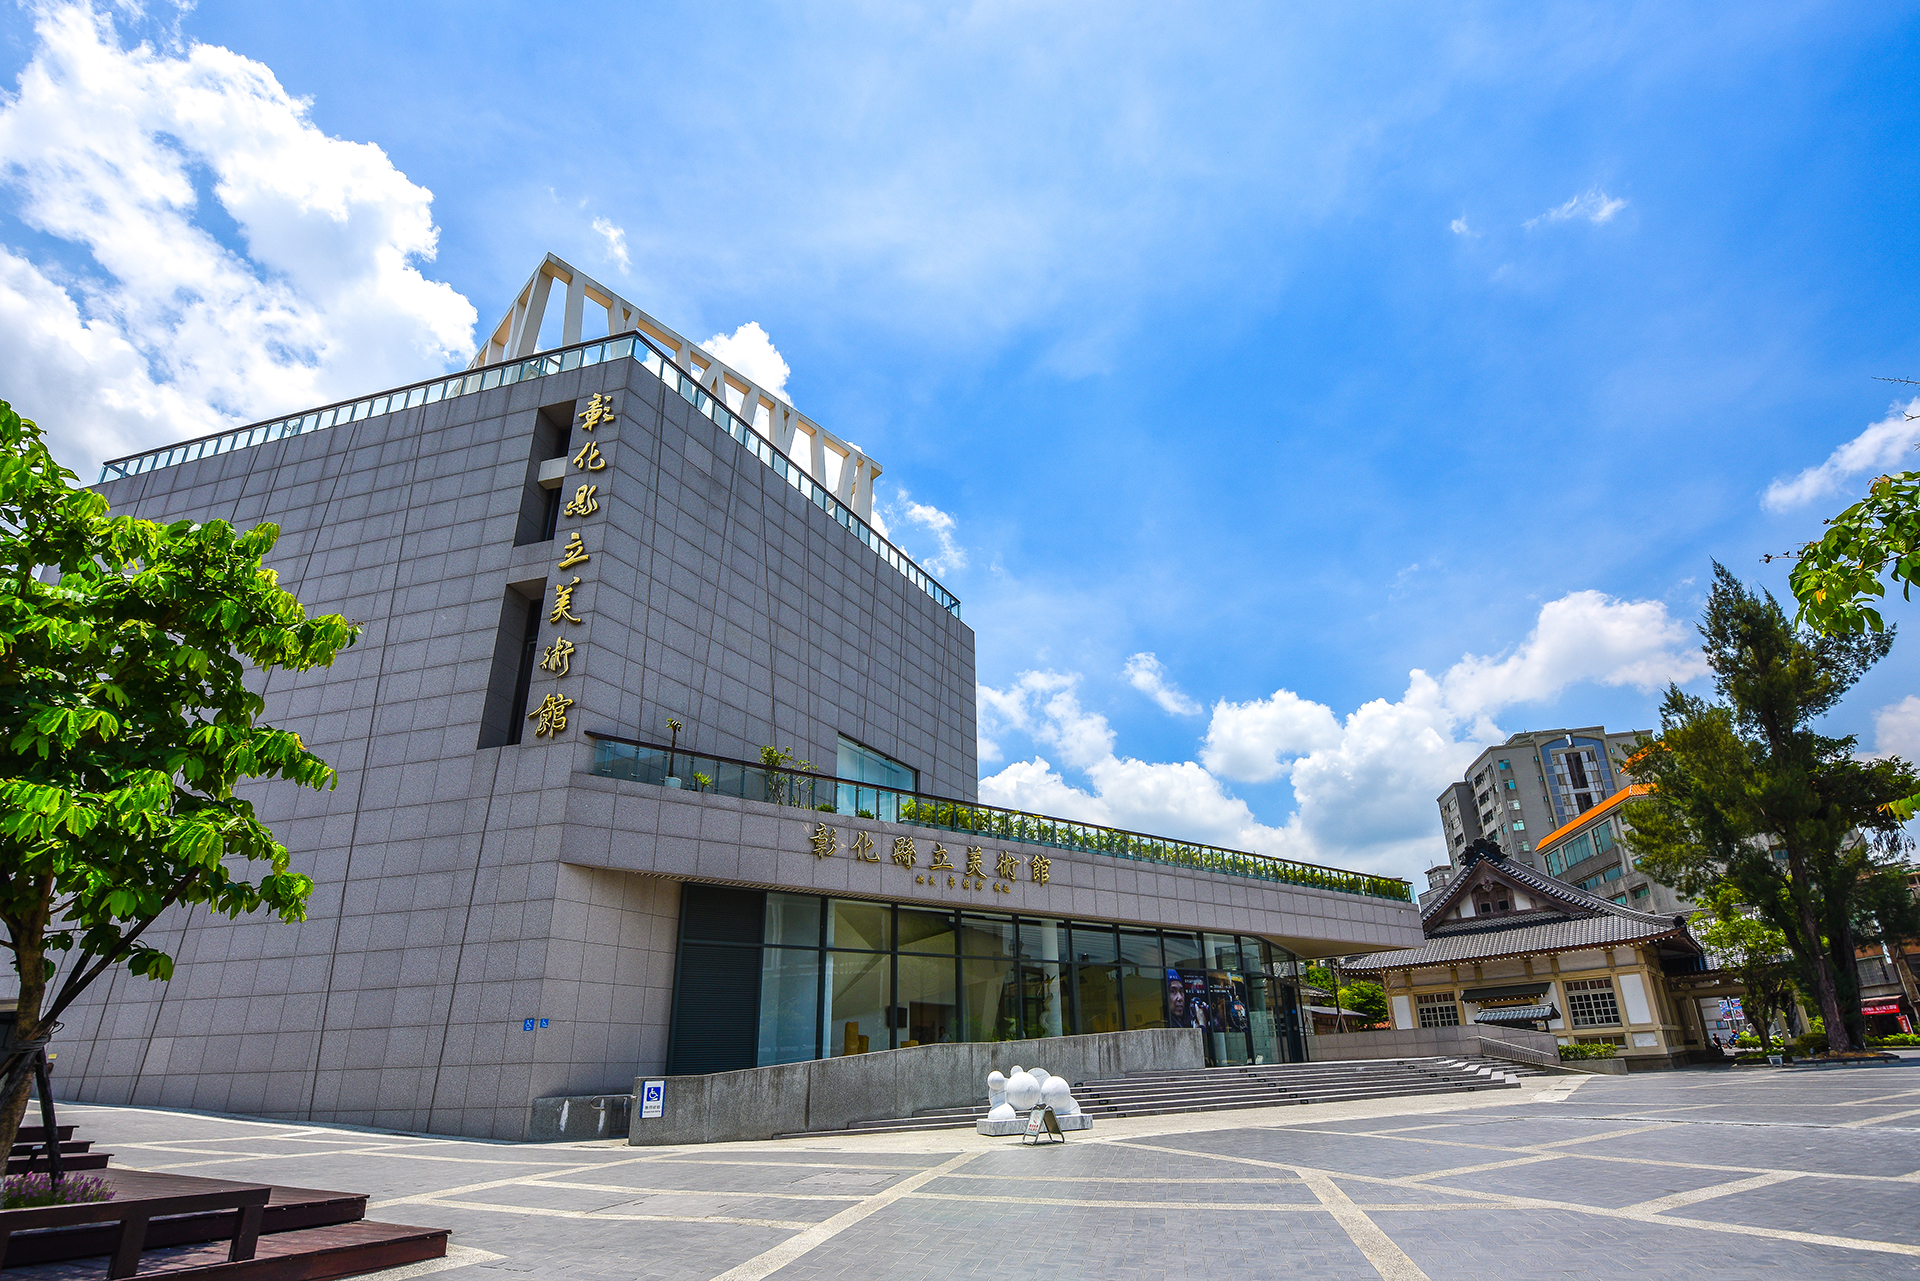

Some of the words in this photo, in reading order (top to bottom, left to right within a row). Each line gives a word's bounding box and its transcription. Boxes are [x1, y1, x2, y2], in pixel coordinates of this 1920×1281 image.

[528, 392, 615, 740] 彰化縣立美術館
[809, 822, 1052, 887] 彰化縣立美術館
